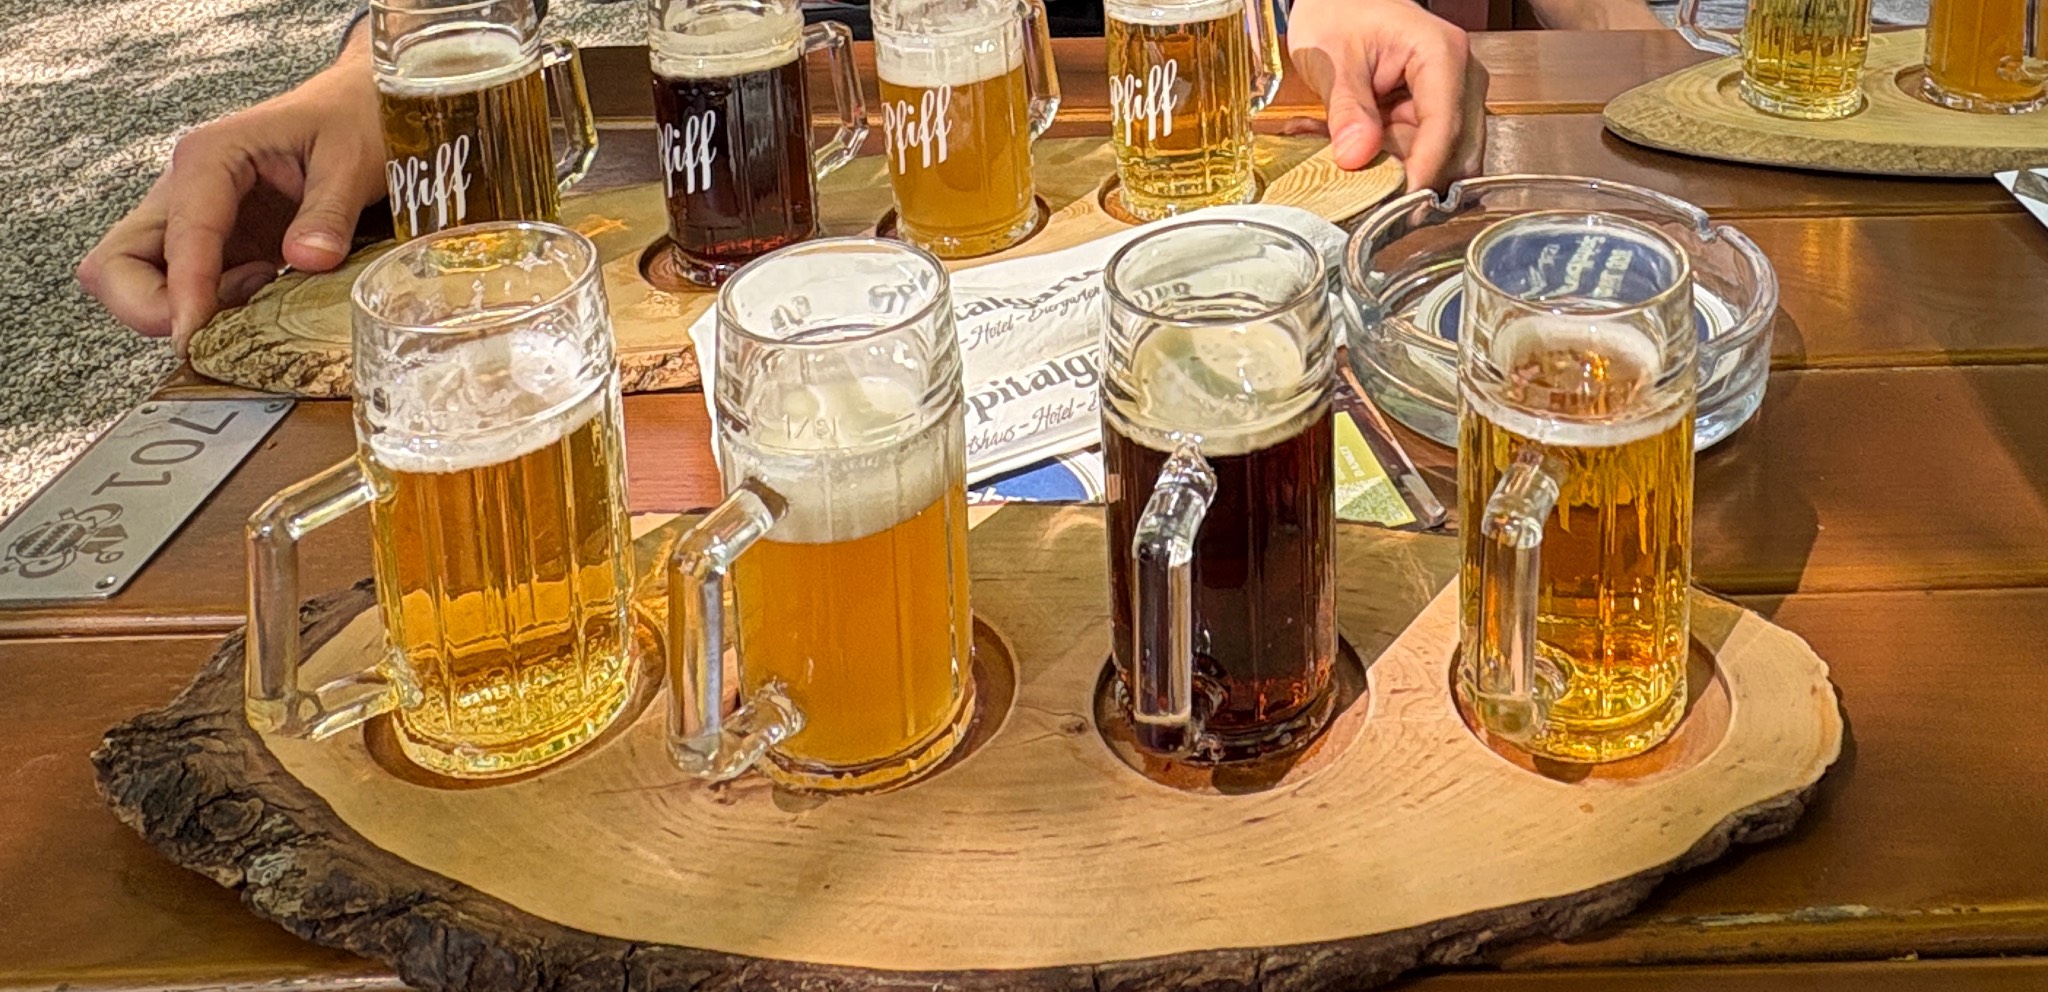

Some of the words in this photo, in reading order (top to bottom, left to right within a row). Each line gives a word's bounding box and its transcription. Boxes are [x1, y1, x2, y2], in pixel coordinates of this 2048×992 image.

[881, 86, 953, 175] Pfiff
[1109, 59, 1178, 146] Pfiff
[386, 134, 472, 236] Pfiff
[968, 314, 1014, 351] Hotel
[964, 351, 1101, 424] pitalg
[1028, 397, 1074, 436] Hotel
